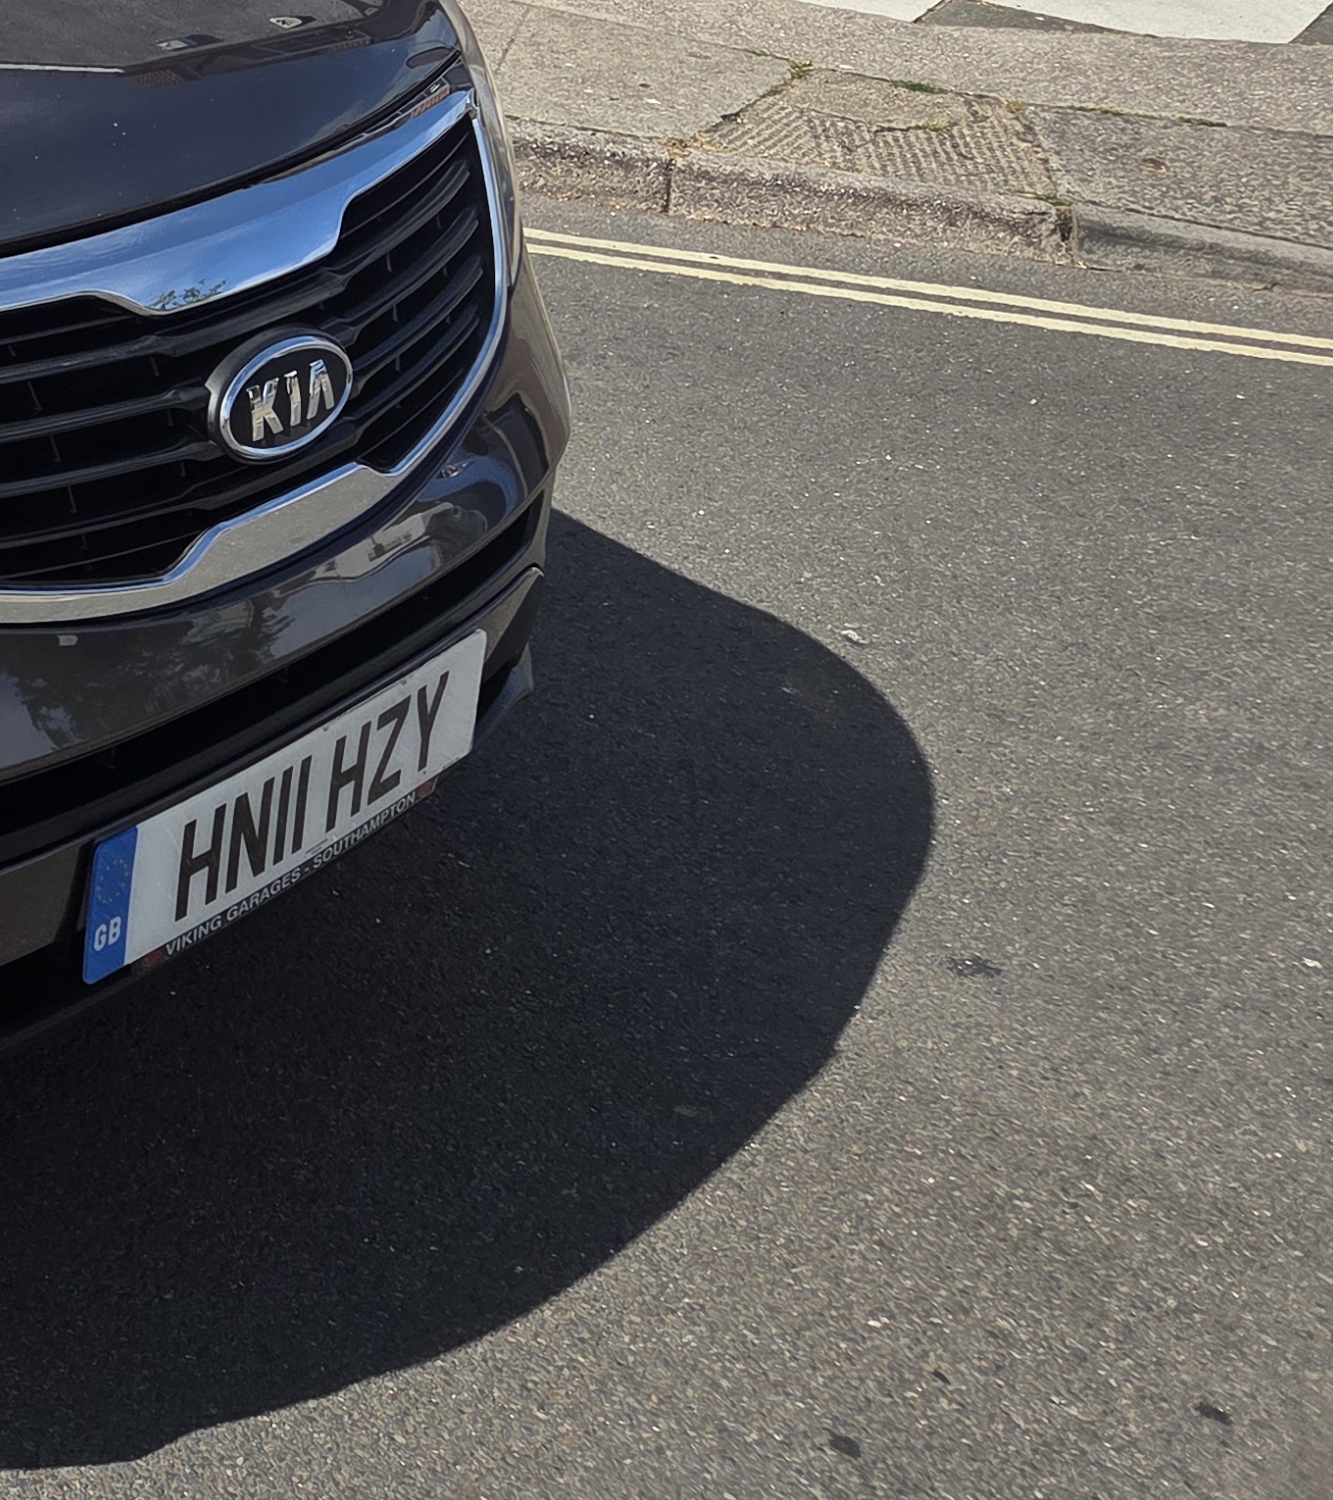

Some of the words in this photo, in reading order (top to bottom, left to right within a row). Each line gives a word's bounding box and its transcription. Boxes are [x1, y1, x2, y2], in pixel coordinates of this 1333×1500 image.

[246, 359, 335, 442] KIA
[174, 754, 313, 923] HN11
[325, 670, 451, 834] HZY
[92, 916, 123, 953] GB
[165, 914, 222, 957] VIKING
[225, 867, 302, 922] GARAGES
[312, 791, 417, 870] SOUTHAMPTON
